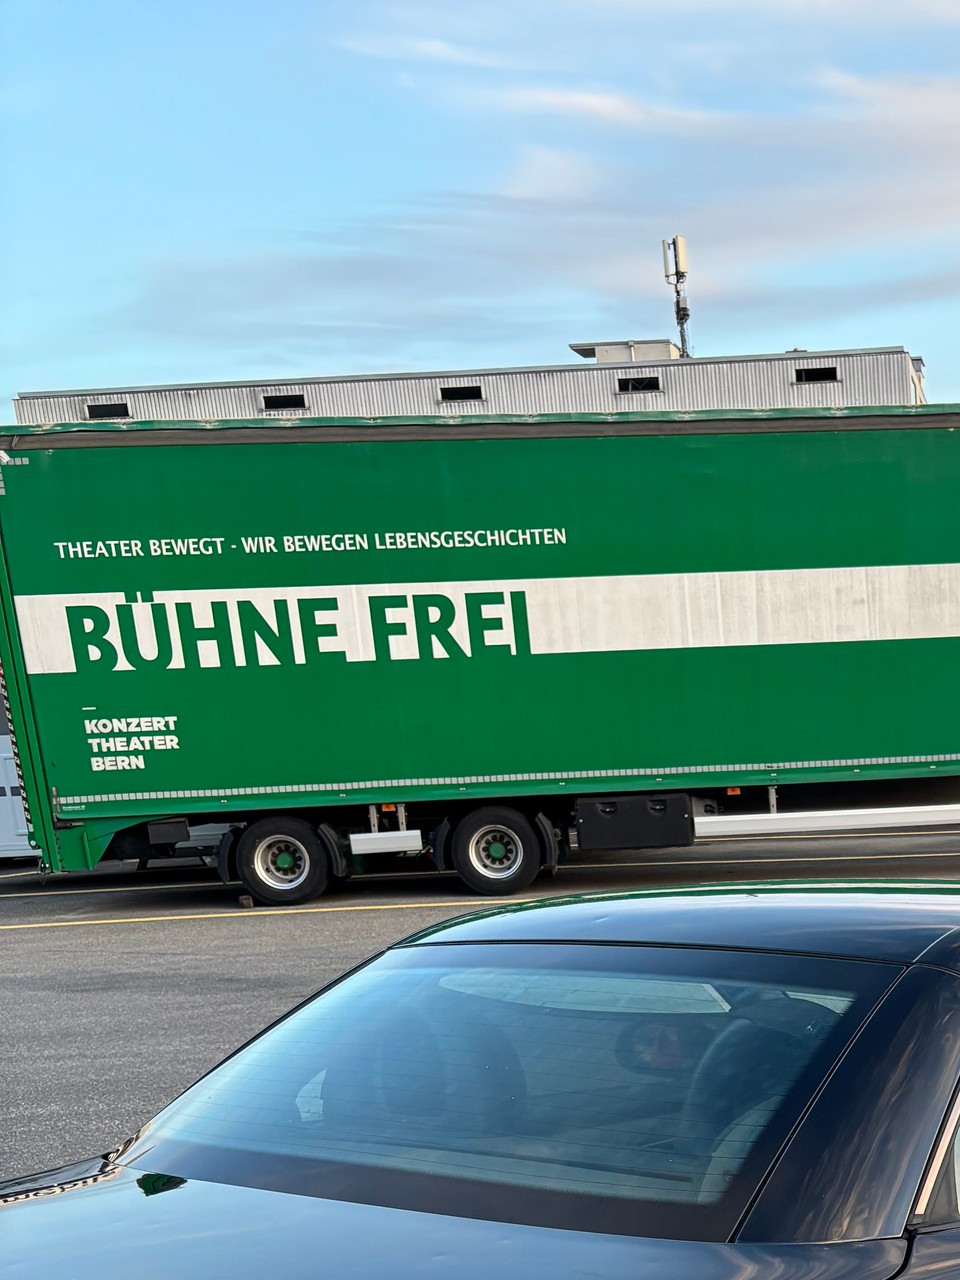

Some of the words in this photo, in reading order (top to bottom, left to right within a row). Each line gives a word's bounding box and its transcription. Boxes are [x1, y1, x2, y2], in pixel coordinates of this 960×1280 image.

[54, 541, 144, 560] THEATER
[149, 537, 225, 556] BEWEGT
[241, 536, 279, 554] WIR
[282, 533, 369, 552] BEWEGEN
[374, 527, 567, 550] LEBENSGESCHICHTEN
[65, 590, 348, 673] BÜHNE
[368, 589, 532, 663] FREI
[84, 716, 178, 734] KONZERT
[88, 734, 180, 752] THEATER
[90, 754, 145, 771] BERN
